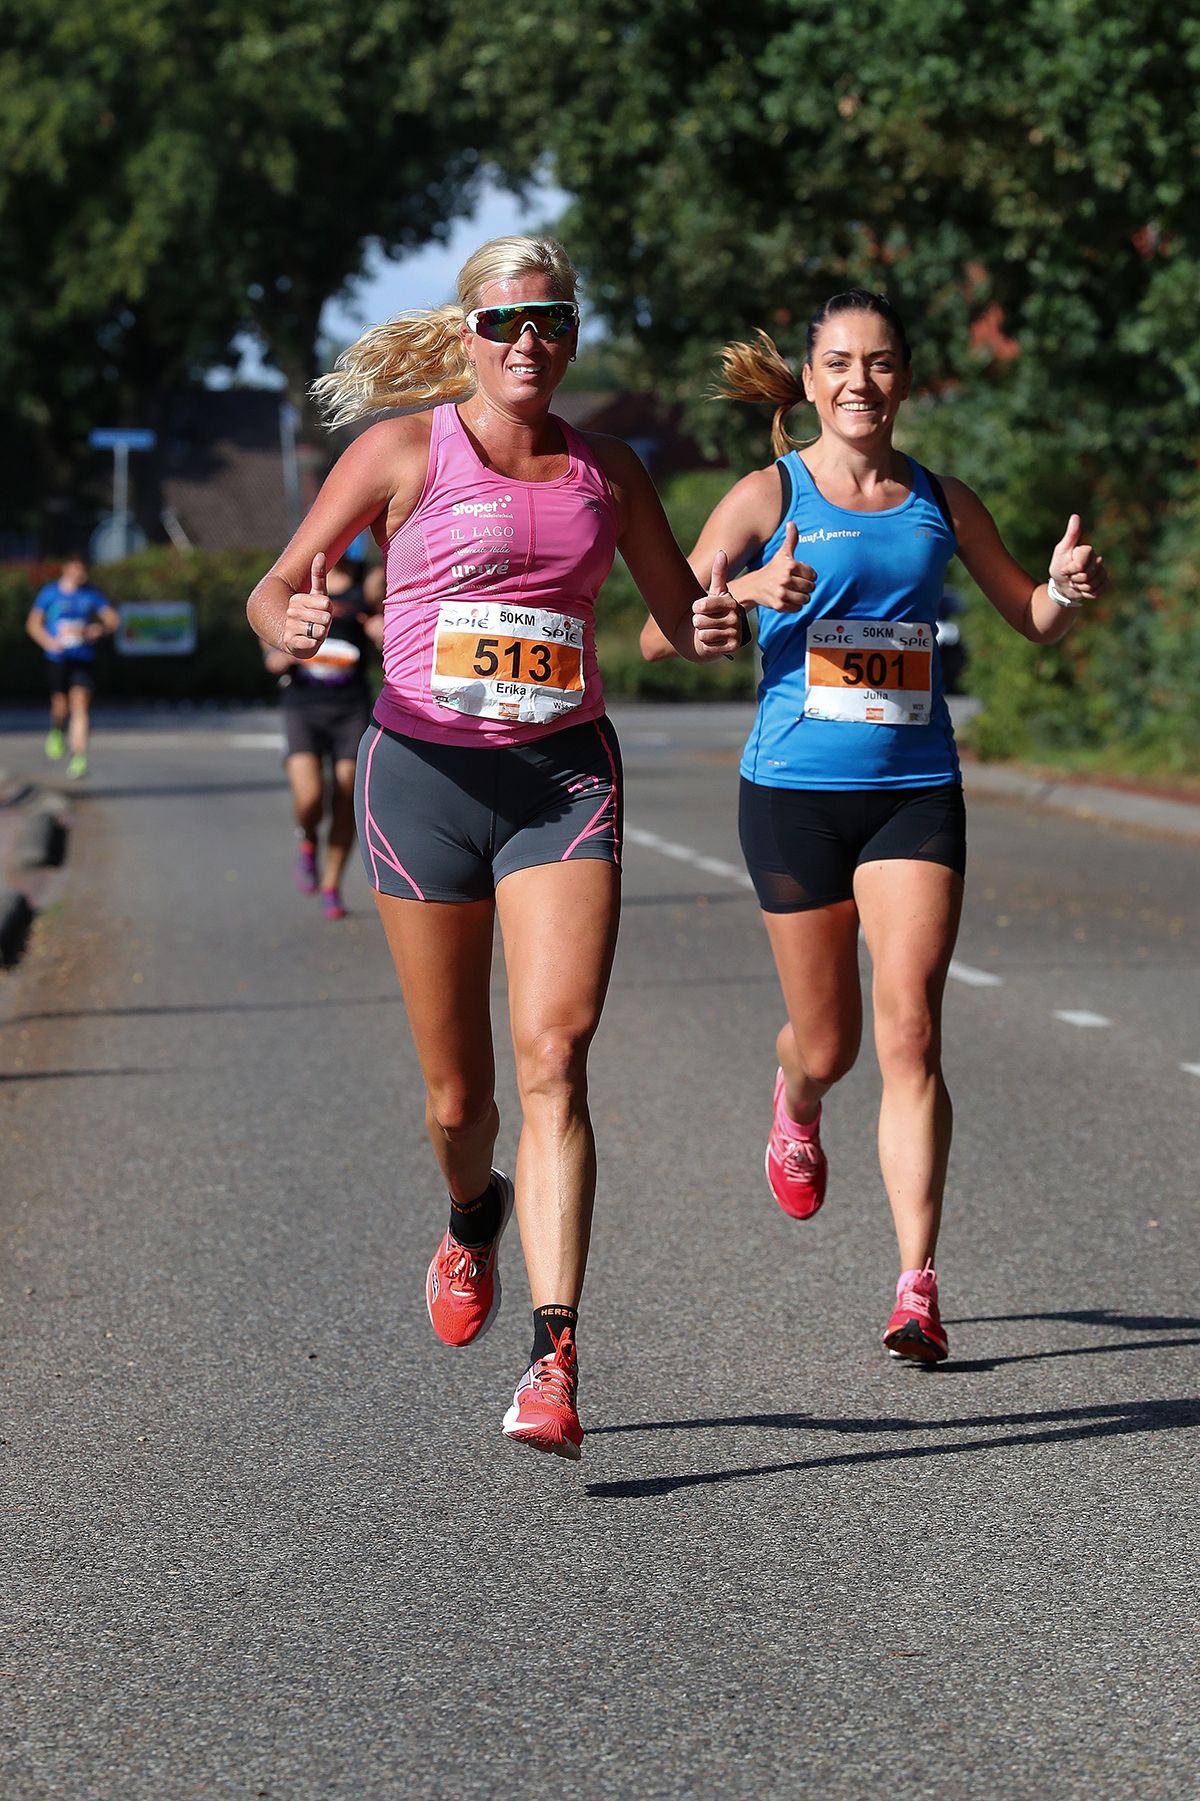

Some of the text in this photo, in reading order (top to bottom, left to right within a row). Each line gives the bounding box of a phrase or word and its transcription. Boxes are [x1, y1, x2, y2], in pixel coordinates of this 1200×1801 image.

[452, 501, 498, 517] Stopet
[450, 525, 514, 540] IL LAGO
[826, 530, 861, 541] partner
[499, 611, 535, 626] 50KM
[862, 627, 894, 638] 50KM
[473, 638, 552, 683] 513
[842, 652, 905, 688] 501
[496, 683, 527, 696] Erika
[863, 690, 889, 700] Julia
